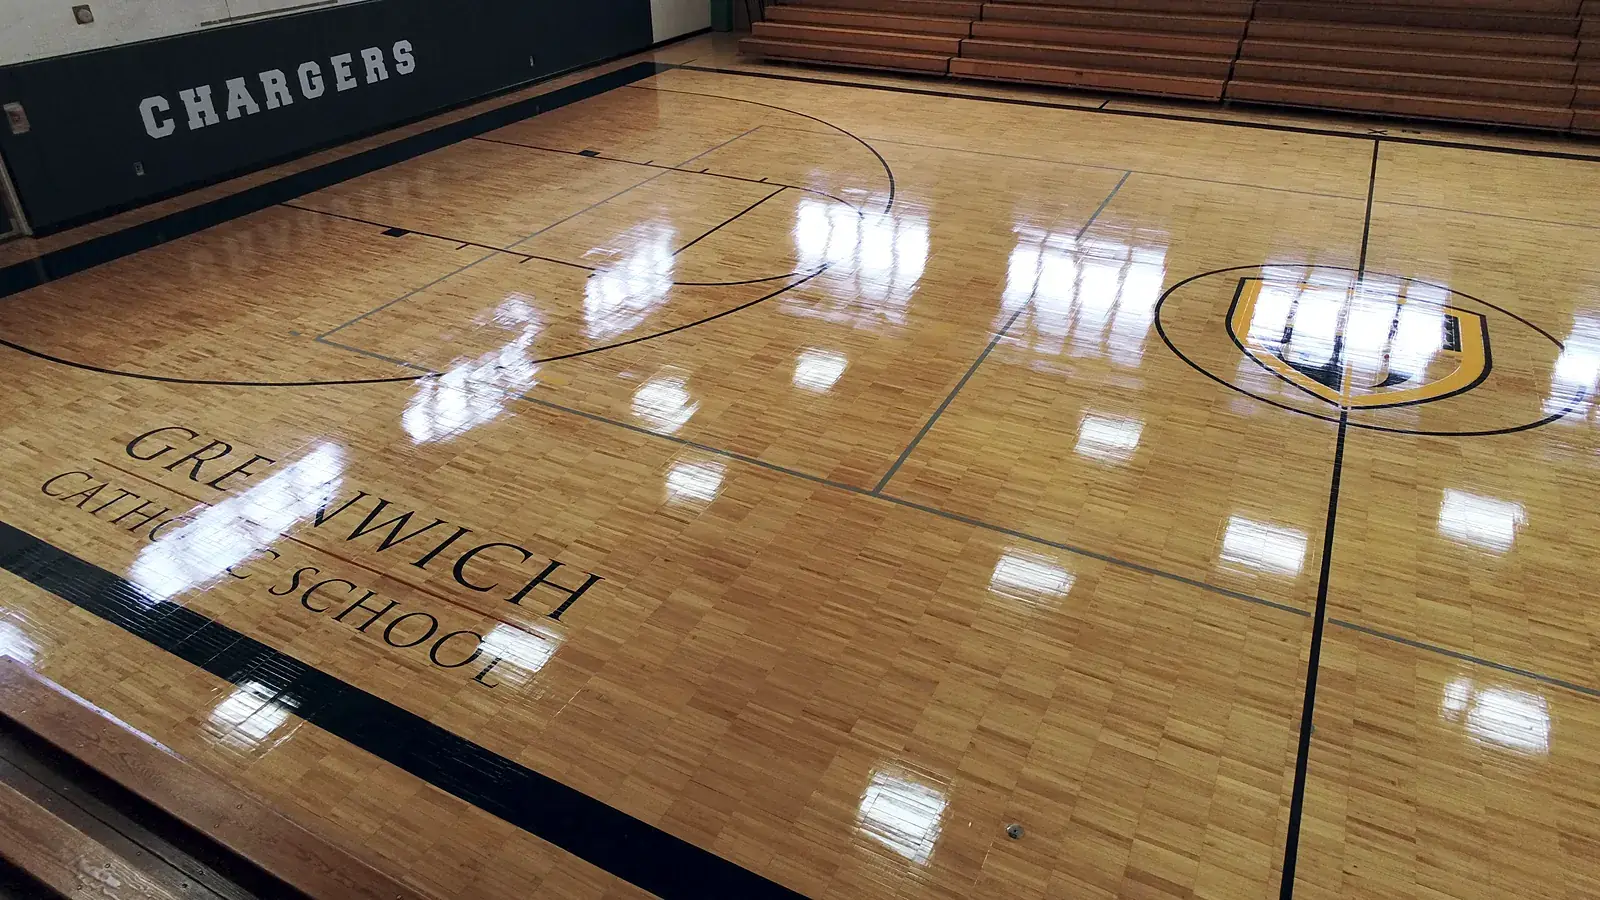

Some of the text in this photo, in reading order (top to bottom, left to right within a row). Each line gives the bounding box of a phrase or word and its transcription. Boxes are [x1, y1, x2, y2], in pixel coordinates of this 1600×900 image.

[139, 39, 416, 139] CHARGERS
[41, 471, 502, 689] CATHC SCHOOL
[126, 426, 605, 621] GRENWICH
